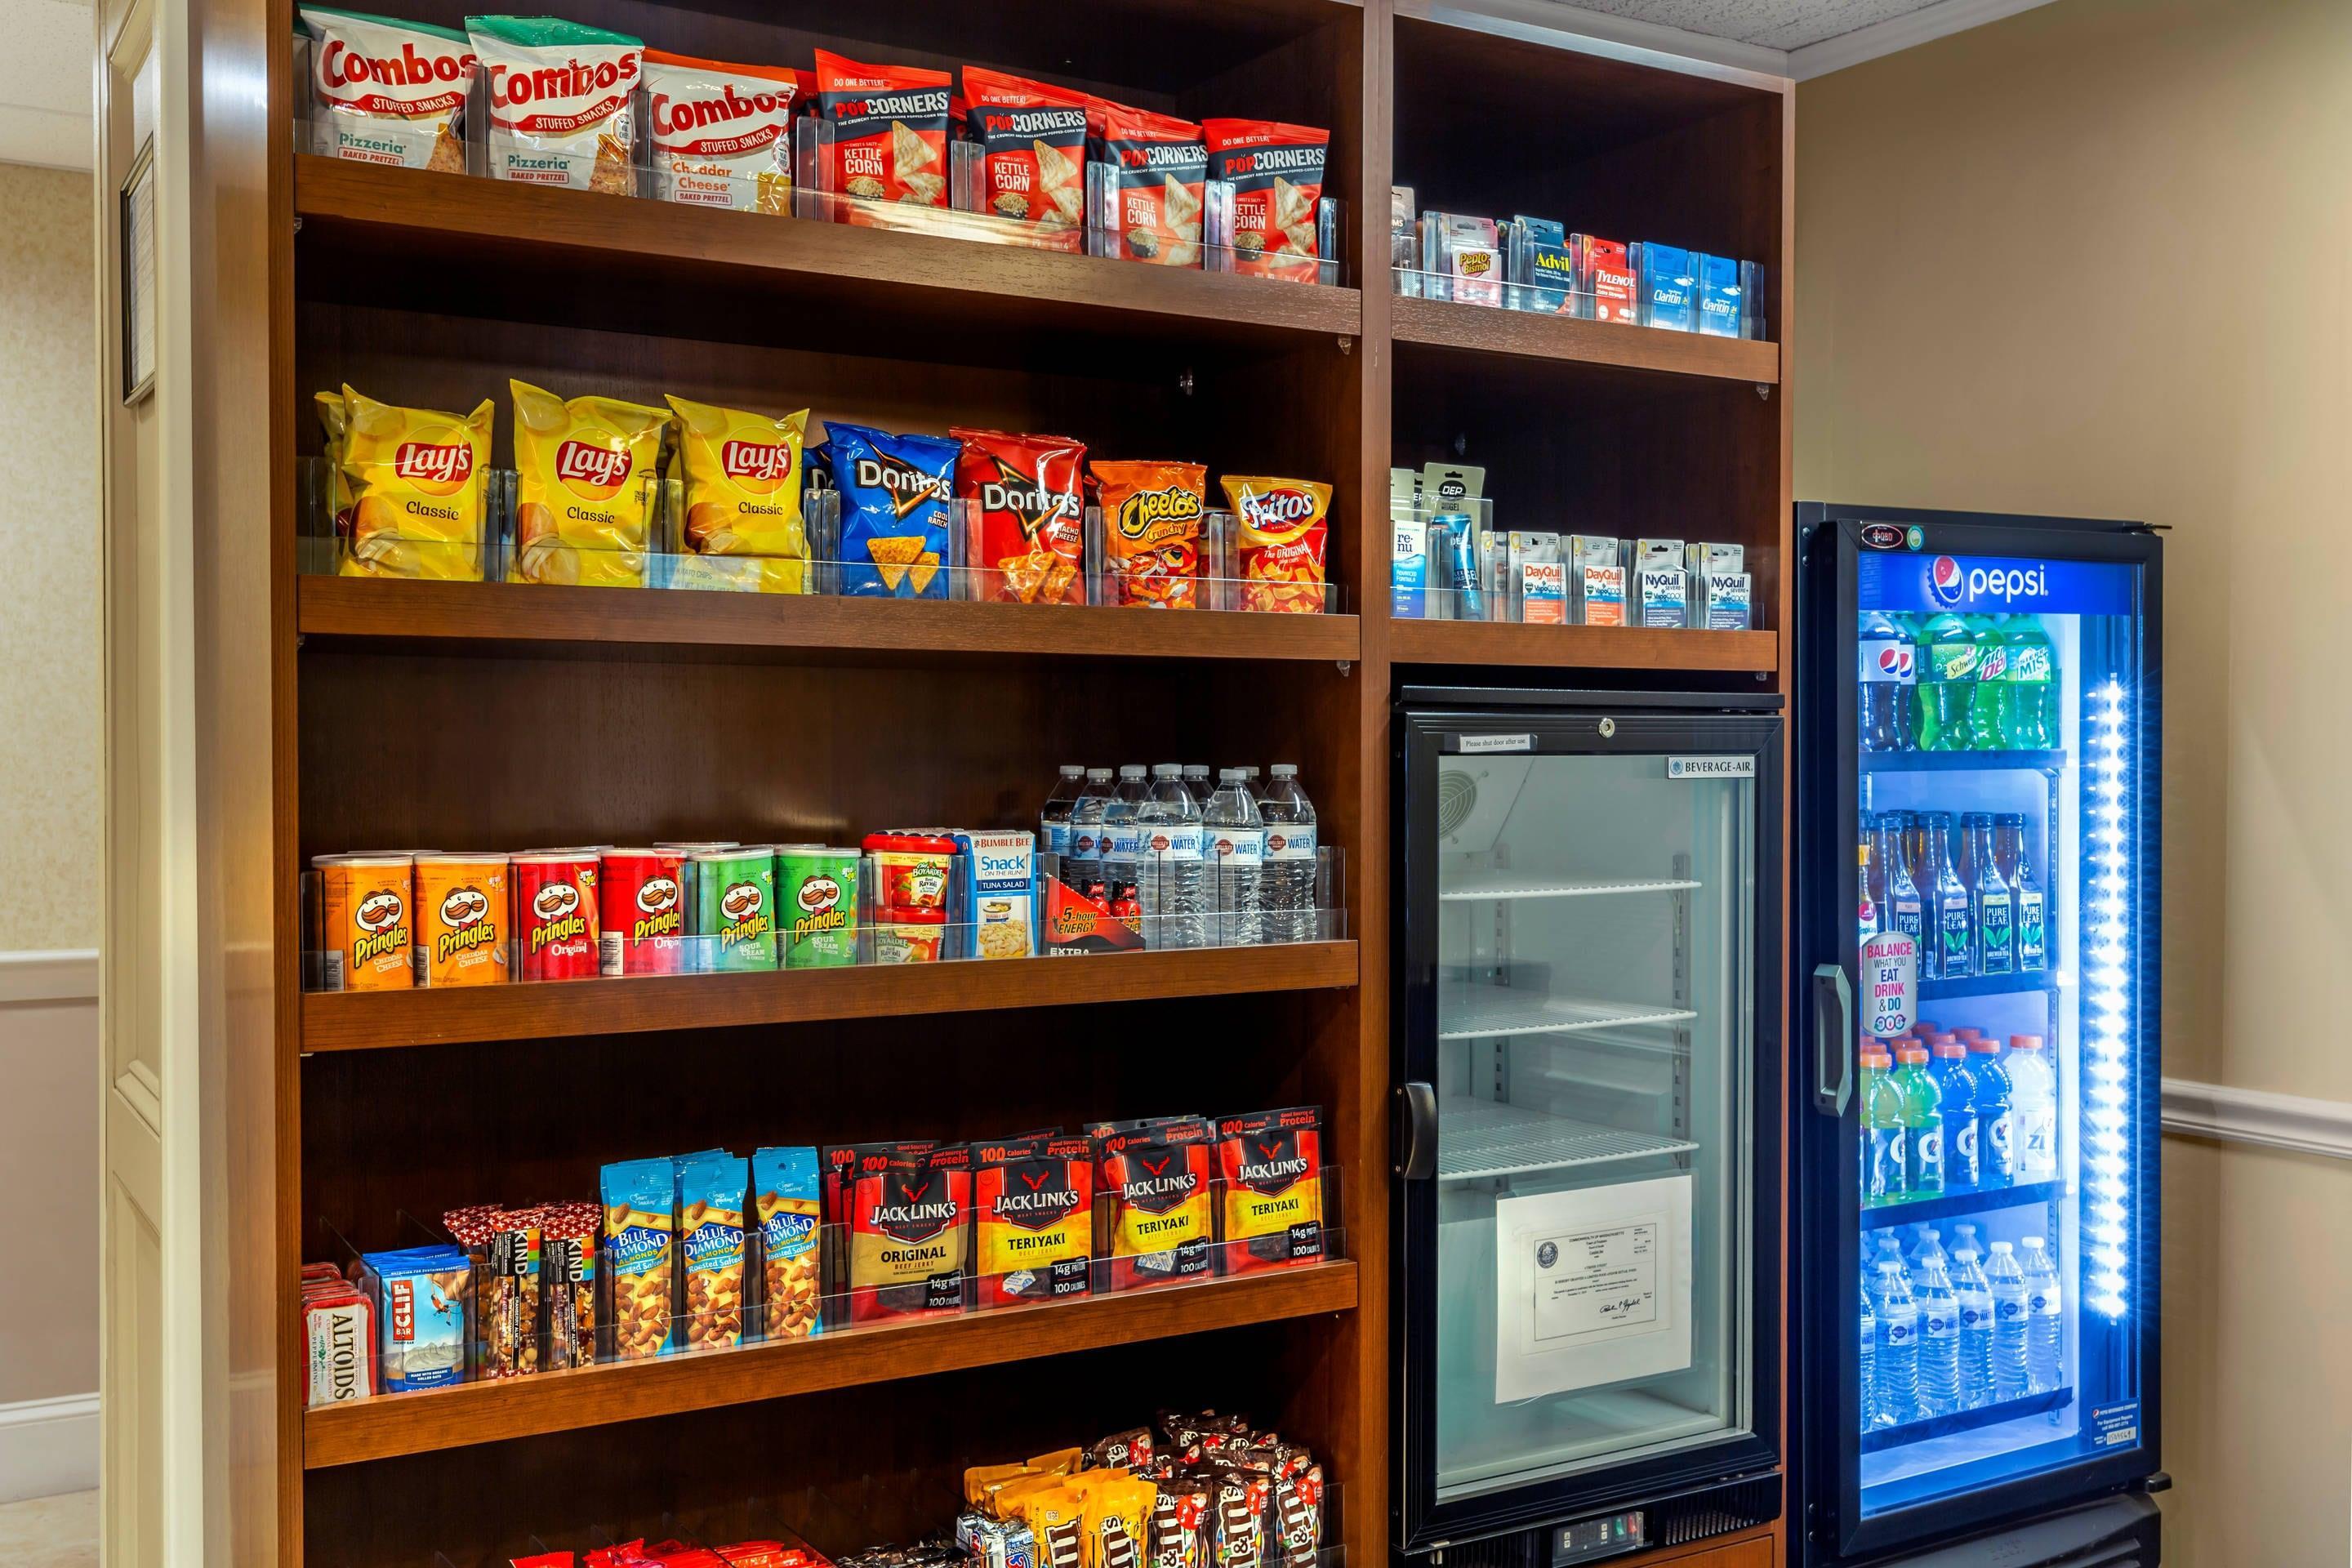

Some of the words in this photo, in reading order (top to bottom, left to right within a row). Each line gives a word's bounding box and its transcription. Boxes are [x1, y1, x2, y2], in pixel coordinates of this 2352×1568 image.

[323, 40, 477, 88] Combos
[490, 53, 638, 109] Combos
[372, 97, 414, 114] STUFFED
[416, 95, 456, 112] SNACKS
[652, 84, 791, 136] Combos
[835, 91, 948, 118] POPCORNERS
[535, 117, 575, 130] STUFFED
[577, 100, 614, 124] SNACKS
[986, 110, 1086, 132] POPCORNERS
[339, 132, 403, 154] Pizzeria
[701, 140, 738, 153] STUFFED
[740, 128, 773, 149] SNACKS
[342, 149, 368, 161] BAKED
[369, 154, 400, 166] PRETZEL
[508, 155, 568, 170] Pizzeria
[844, 148, 882, 161] KETTLE
[1120, 145, 1209, 167] POPCORNERS
[1225, 148, 1325, 175] POPCORNERS
[845, 158, 884, 176] CORN
[994, 162, 1030, 176] KETTLE
[679, 177, 728, 192] Cheese
[995, 174, 1030, 192] CORN
[1127, 197, 1156, 213] KETTLE
[1127, 210, 1156, 228] CORN
[1463, 260, 1490, 274] Bismol
[1535, 252, 1570, 272] Advil
[1597, 269, 1636, 287] TYLENOL
[1654, 289, 1681, 305] Claritin
[1703, 299, 1730, 314] Claritin
[401, 443, 470, 483] Lay's
[560, 442, 629, 486] Lay's
[728, 442, 788, 480] Lay's
[859, 460, 951, 501] Doritos
[1441, 485, 1463, 496] DEP
[738, 501, 783, 515] Classic
[984, 484, 1080, 516] Doritos
[406, 501, 459, 520] Classic
[567, 506, 615, 523] Classic
[933, 510, 948, 520] COOL
[1122, 488, 1199, 533] Cheetos
[1240, 491, 1314, 529] Fritos
[928, 516, 947, 528] RANCH
[1055, 532, 1078, 542] CHEESE
[1145, 523, 1186, 543] Crunchy
[1264, 550, 1276, 559] The
[1586, 568, 1622, 582] DayQuil
[1646, 573, 1680, 589] NyQuil
[1711, 574, 1745, 589] NyQuil
[1969, 564, 2046, 603] pepsi
[1685, 760, 1751, 773] BEVERAGE-AIR
[980, 838, 1013, 848] BUMBLE
[1015, 838, 1031, 848] BEE
[1171, 838, 1196, 850] WATER
[1235, 844, 1258, 855] WATER
[1287, 838, 1311, 849] WATER
[981, 855, 1025, 871] Snack
[912, 867, 943, 878] BOYARDEE
[982, 881, 1001, 889] TUNA
[1003, 880, 1025, 889] SALAD
[1062, 906, 1098, 922] 5-hour
[1946, 911, 1966, 921] PURE
[1986, 907, 2007, 916] PURE
[2022, 906, 2040, 915] PURE
[795, 909, 845, 944] Pringles
[1058, 921, 1096, 934] ENERGY
[1899, 915, 1918, 924] PURE
[1986, 915, 2008, 925] LEAF
[2022, 915, 2041, 924] LEAF
[532, 915, 586, 955] Pringles
[720, 912, 768, 954] Pringles
[1899, 924, 1918, 933] LEAF
[354, 926, 408, 969] Pringles
[439, 923, 495, 963] Pringles
[739, 942, 761, 952] SOUR
[812, 936, 834, 945] SOUR
[813, 942, 838, 950] CREAM
[456, 949, 488, 961] CHEDDAR
[551, 942, 587, 956] Original
[741, 948, 765, 956] CREAM
[1867, 942, 1912, 959] BALANCE
[373, 953, 403, 966] CHEDDAR
[376, 960, 403, 973] CHEESE
[458, 956, 488, 968] CHEESE
[1873, 959, 1893, 968] WHAT
[1894, 957, 1906, 967] YOU
[1881, 968, 1899, 982] EAT
[1874, 982, 1905, 998] DRINK
[1878, 999, 1886, 1012] &
[1887, 998, 1901, 1011] DO
[1221, 1120, 1243, 1134] 100
[1280, 1115, 1316, 1127] Protein
[1165, 1128, 1203, 1143] Protein
[981, 1147, 1006, 1163] 100
[1007, 1148, 1031, 1156] Calories
[1047, 1144, 1089, 1156] Protein
[862, 1156, 888, 1171] 100
[889, 1159, 915, 1169] Calories
[929, 1154, 969, 1166] Protein
[1237, 1164, 1272, 1181] JACK
[1272, 1157, 1307, 1177] LINK'S
[1122, 1181, 1155, 1200] JACK
[1156, 1174, 1196, 1193] LINK'S
[993, 1195, 1032, 1214] JACK
[1033, 1190, 1079, 1208] LINK'S
[1251, 1198, 1299, 1216] TERIYAKI
[870, 1205, 910, 1224] JACK
[911, 1201, 957, 1220] LINK'S
[768, 1214, 798, 1232] BLUE
[1137, 1215, 1189, 1235] TERIYAKI
[618, 1228, 650, 1247] BLUE
[696, 1225, 728, 1243] BLUE
[1008, 1232, 1066, 1250] TERIYAKI
[514, 1229, 528, 1275] KIND
[684, 1231, 745, 1257] DIAMOND
[792, 1241, 815, 1254] Salted
[568, 1238, 583, 1282] KIND
[619, 1250, 658, 1265] ALMONDS
[697, 1245, 735, 1262] ALMONDS
[880, 1246, 947, 1263] ORIGINAL
[688, 1258, 718, 1274] Roasted
[720, 1254, 743, 1267] Salted
[394, 1284, 412, 1328] CLIF
[332, 1312, 355, 1400] ALTOIDS
